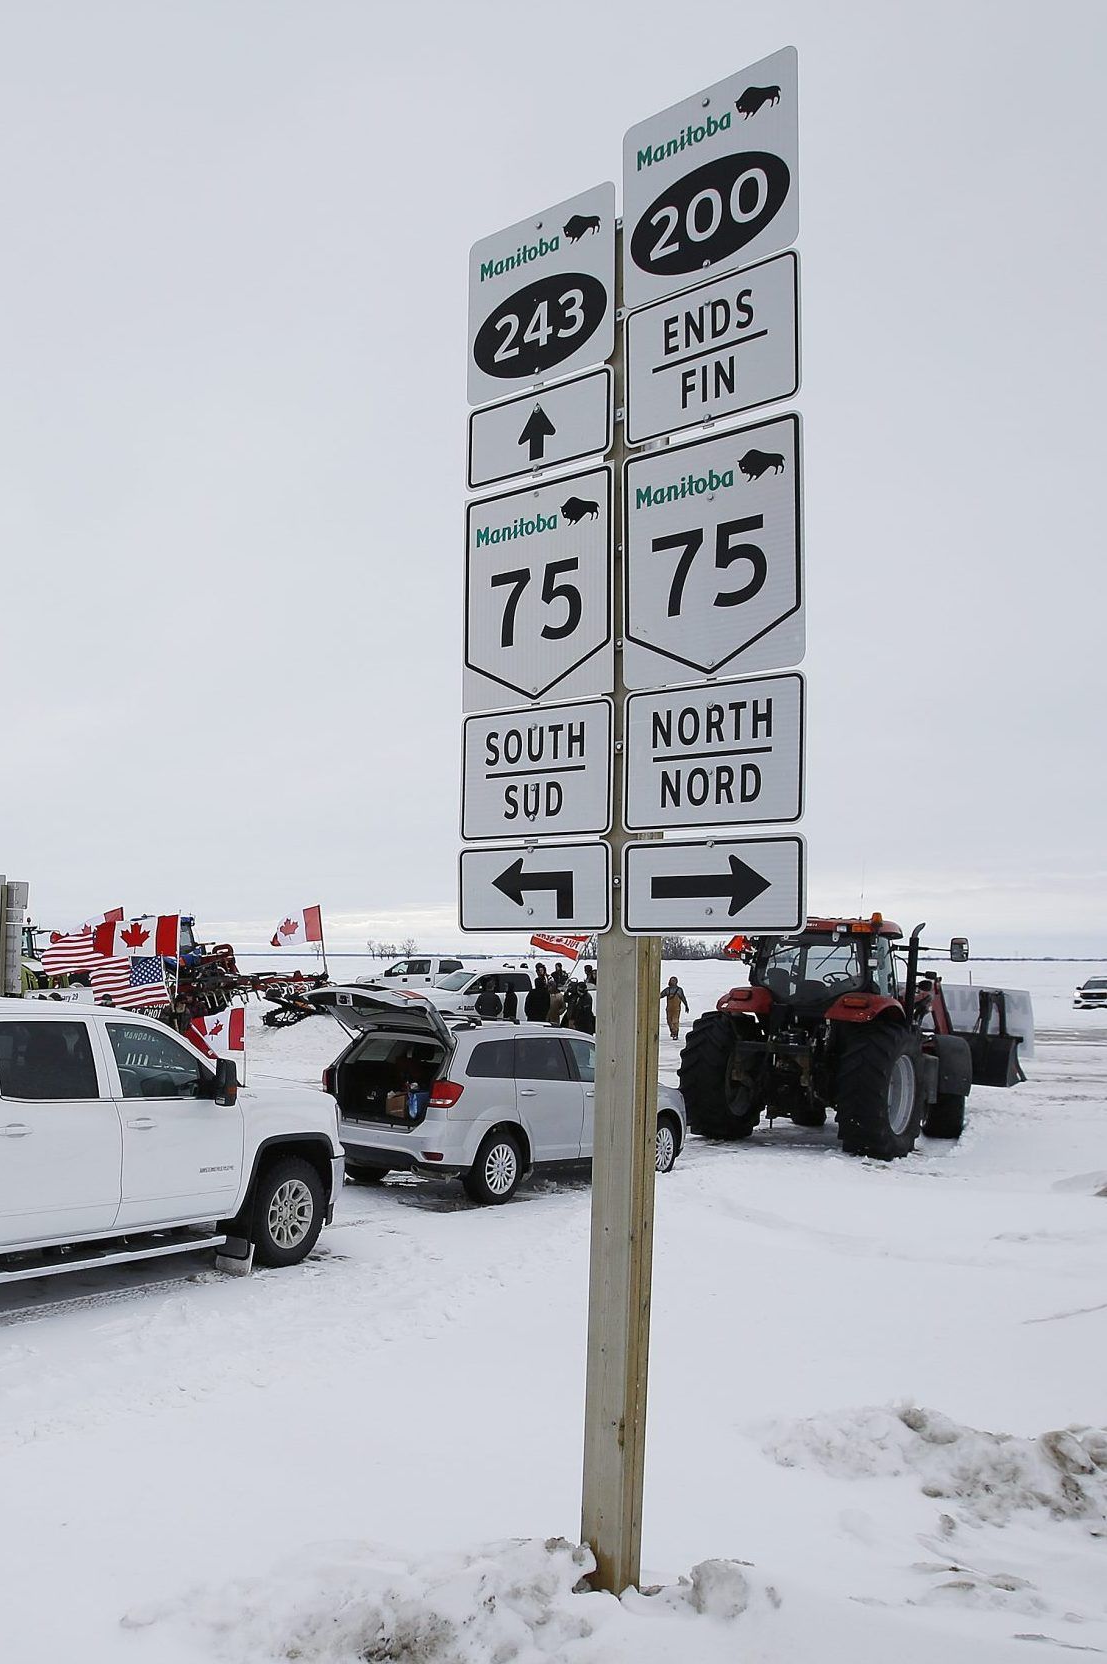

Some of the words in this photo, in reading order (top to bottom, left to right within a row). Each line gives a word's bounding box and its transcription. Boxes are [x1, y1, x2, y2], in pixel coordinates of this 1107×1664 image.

[636, 111, 732, 171] Manitoba
[649, 167, 768, 262] 200
[480, 234, 560, 282] Manitoba
[493, 288, 585, 363] 243
[663, 289, 754, 356] ENDS
[681, 356, 735, 410] FIN
[636, 469, 734, 510] Manitoba
[476, 511, 558, 548] Manitoba
[651, 513, 768, 618] 75
[491, 557, 583, 648] 75
[485, 720, 585, 767] SOUTH
[651, 697, 773, 749] NORTH
[503, 781, 563, 820] SUD
[660, 763, 762, 809] NORD
[143, 1008, 162, 1019] CHOI
